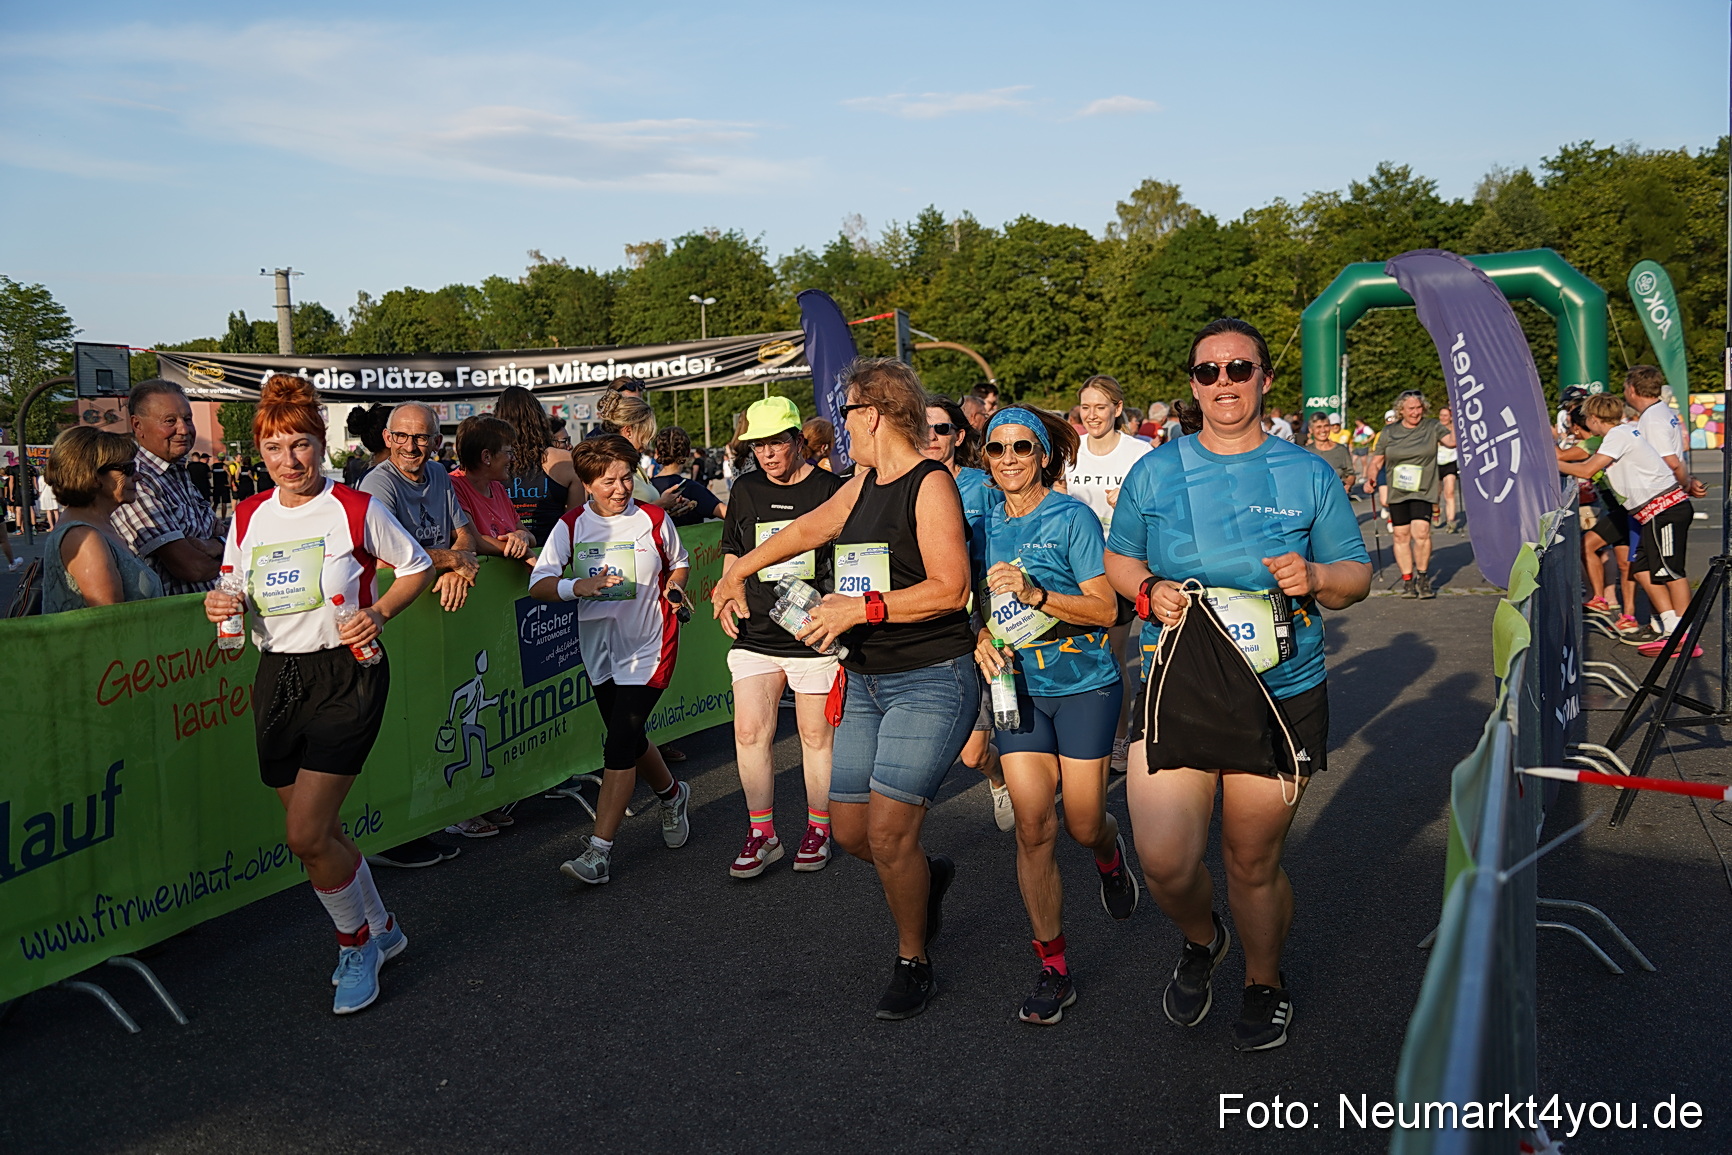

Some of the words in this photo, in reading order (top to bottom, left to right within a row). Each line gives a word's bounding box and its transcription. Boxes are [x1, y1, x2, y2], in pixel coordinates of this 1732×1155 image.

[260, 367, 308, 387] Af
[313, 366, 356, 389] die
[361, 367, 451, 390] Plätze.
[456, 362, 542, 391] Fertig.
[548, 355, 722, 384] Miteinander.
[1305, 396, 1329, 408] AOK
[1073, 476, 1122, 486] APTIV
[1249, 505, 1261, 514] TR
[1264, 507, 1303, 517] PLAST
[265, 569, 300, 586] 556
[839, 576, 871, 592] 2318
[262, 590, 285, 598] Monika
[286, 586, 306, 594] Galara
[530, 611, 574, 639] Fischer
[1005, 620, 1023, 633] Andrea
[1021, 612, 1036, 624] Hierl
[536, 626, 571, 646] AUTOMOBILE
[1240, 644, 1260, 653] chöll
[173, 677, 255, 741] laufe
[498, 669, 592, 740] firmen
[503, 719, 567, 766] neumarkt
